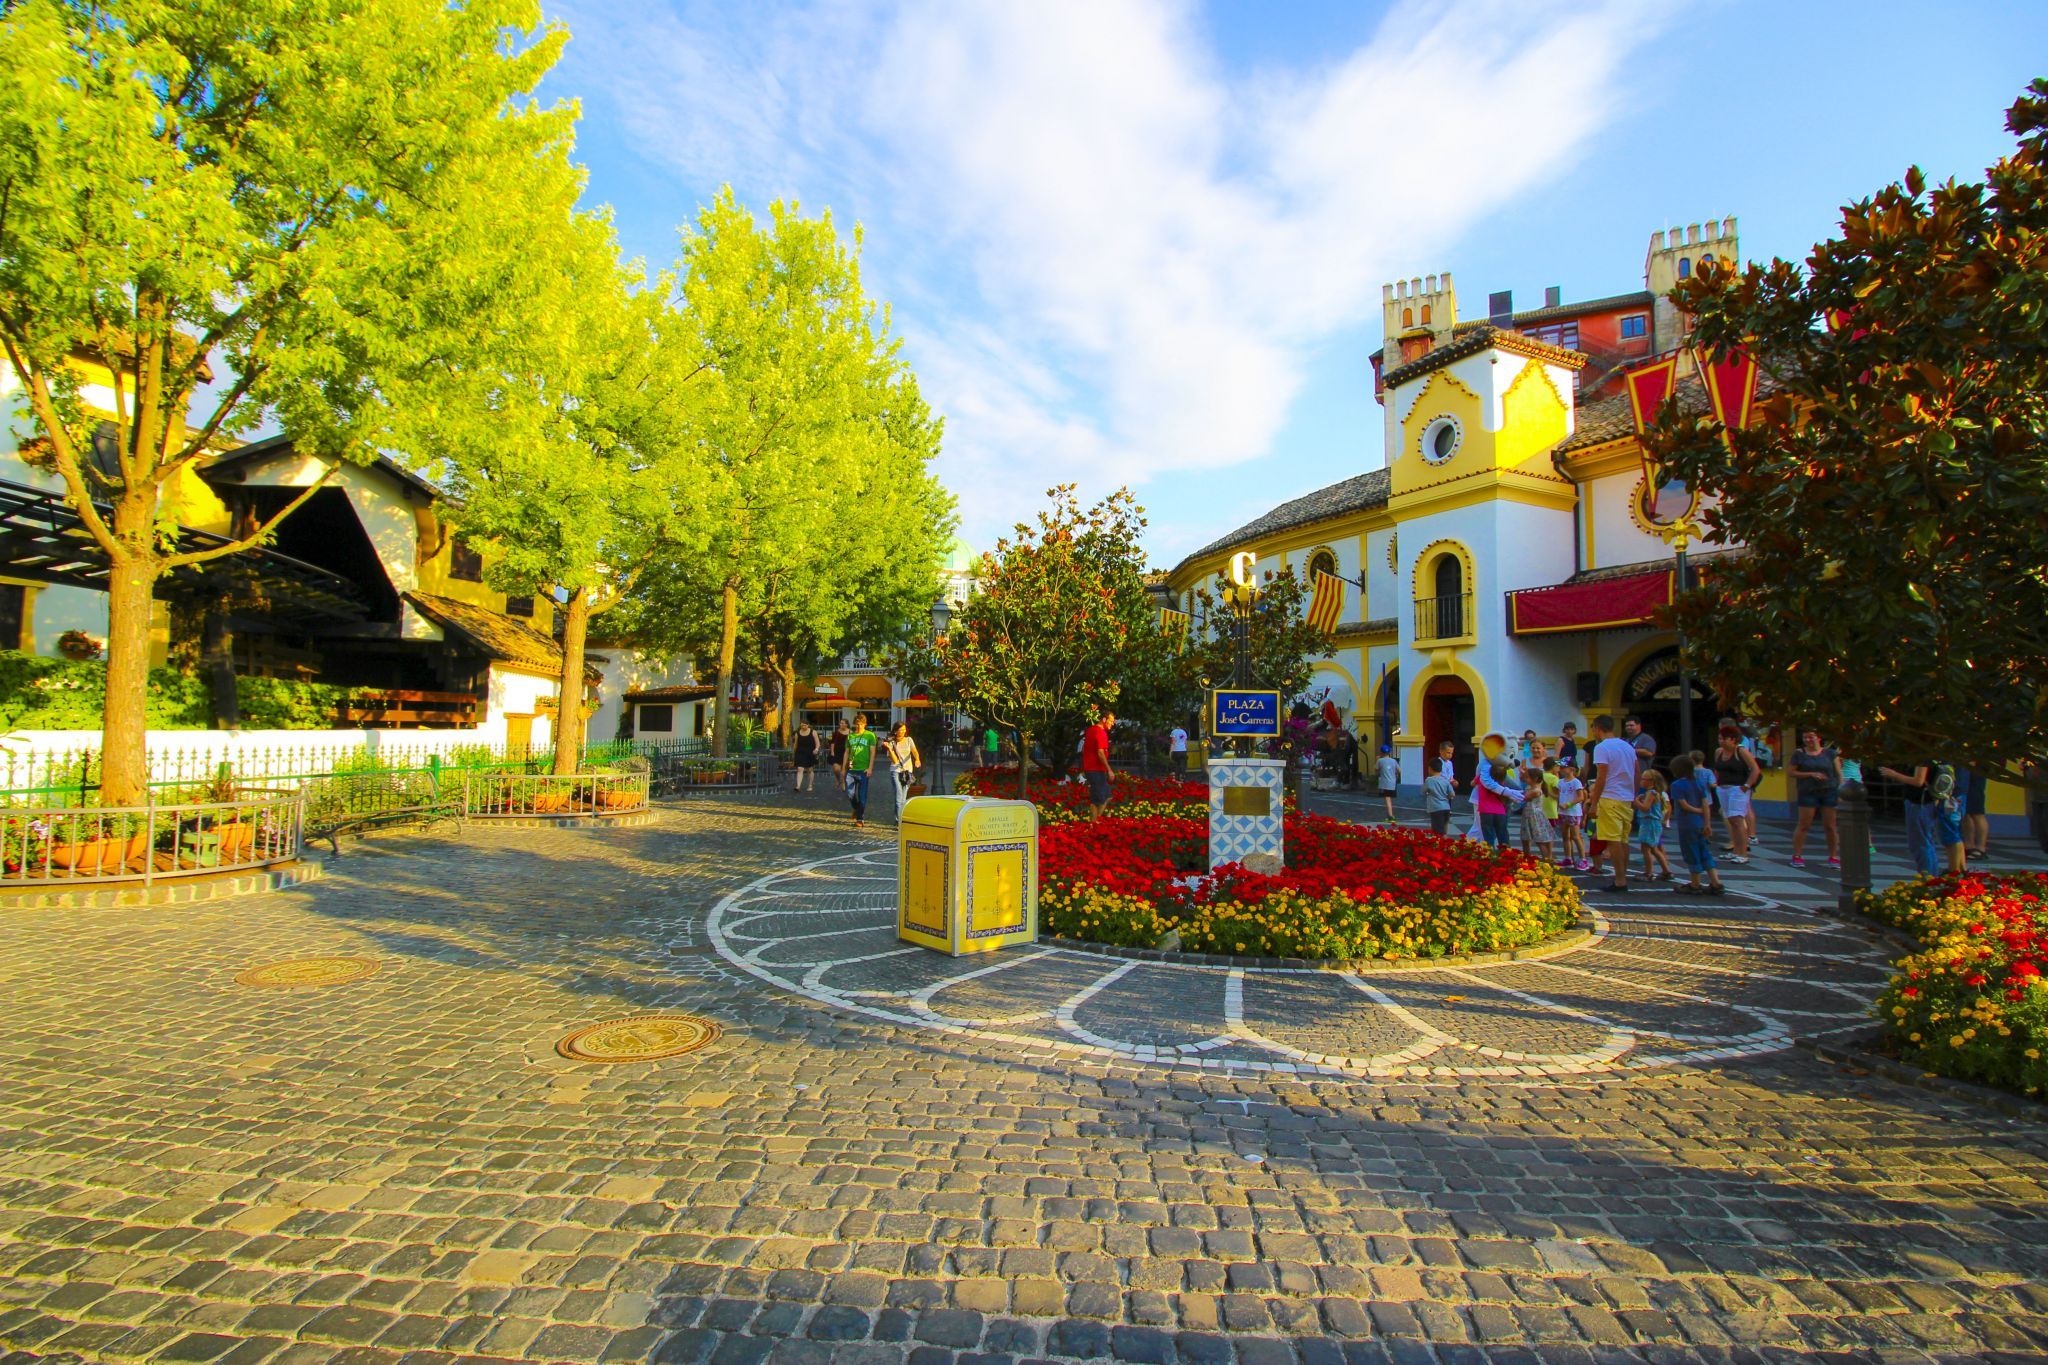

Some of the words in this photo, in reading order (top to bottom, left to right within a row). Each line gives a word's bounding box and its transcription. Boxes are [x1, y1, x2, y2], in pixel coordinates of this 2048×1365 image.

[1228, 699, 1265, 710] PLAZA
[1219, 712, 1238, 724] José
[1239, 712, 1275, 725] Carreras
